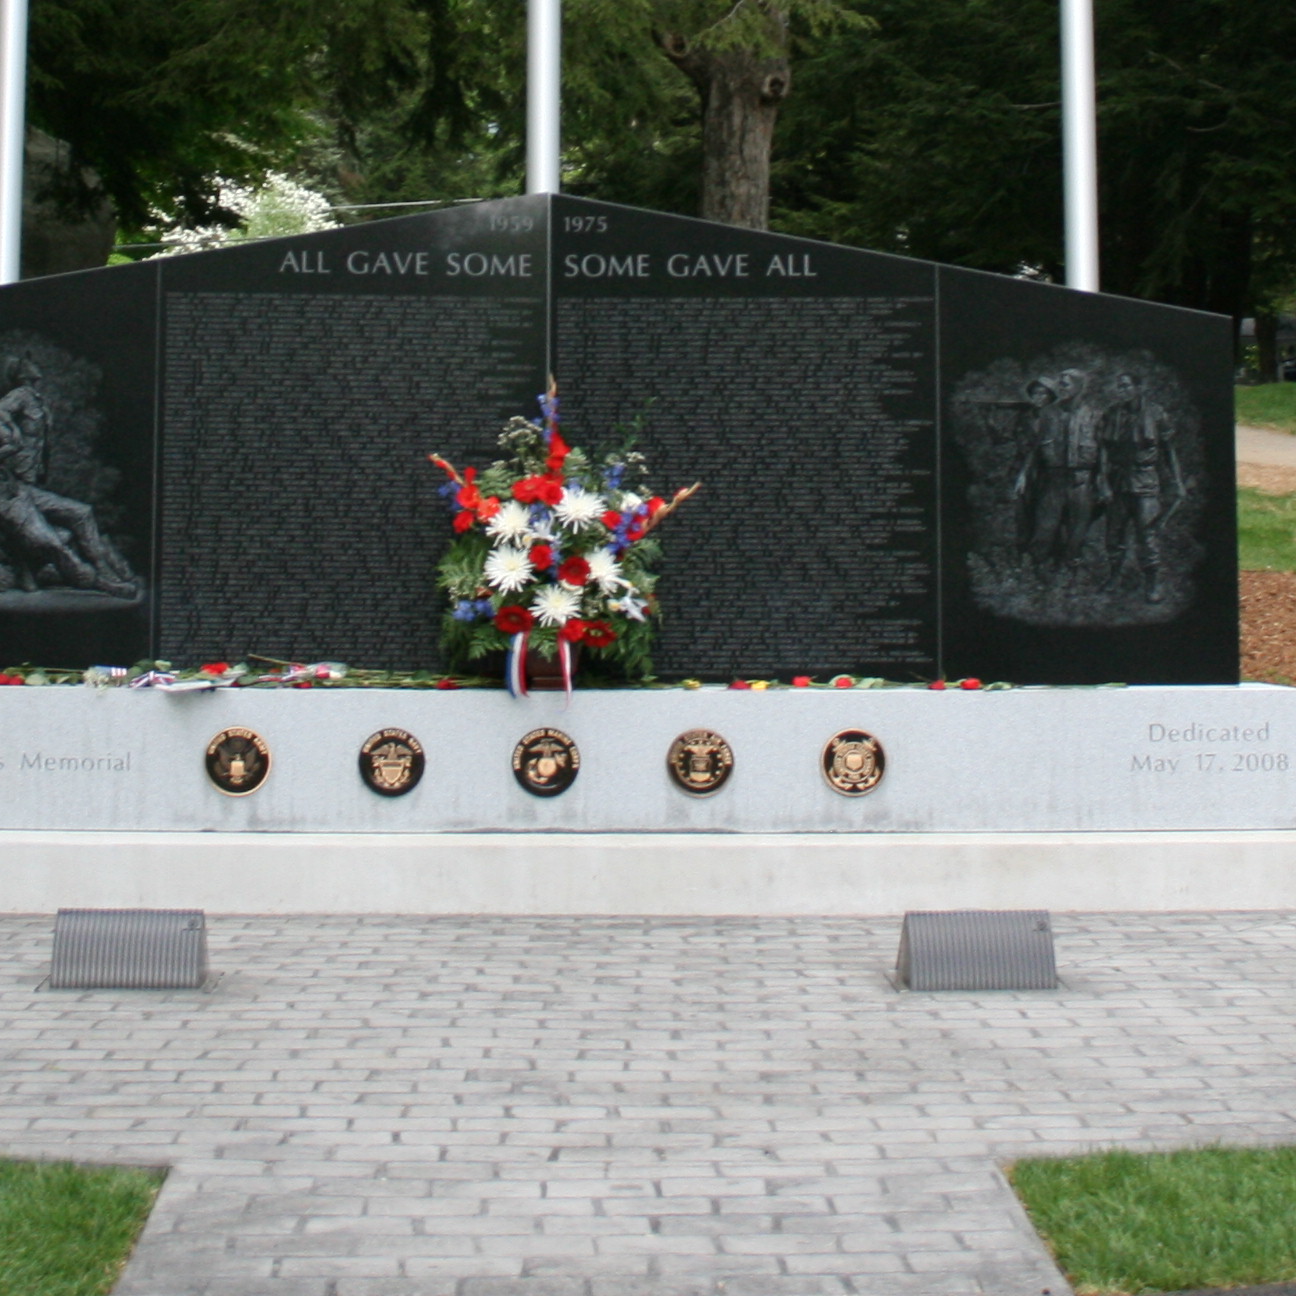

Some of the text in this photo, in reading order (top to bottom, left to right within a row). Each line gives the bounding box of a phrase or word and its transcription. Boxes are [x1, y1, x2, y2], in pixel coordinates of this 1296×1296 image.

[489, 215, 535, 232] 1959
[563, 215, 608, 233] 1975
[279, 250, 533, 278] ALL GAVE SOME
[563, 253, 818, 278] SOME GAVE ALL
[1148, 722, 1270, 743] Dedicated
[20, 751, 131, 772] Memorial
[1130, 754, 1180, 775] May
[1231, 753, 1290, 772] 2008
